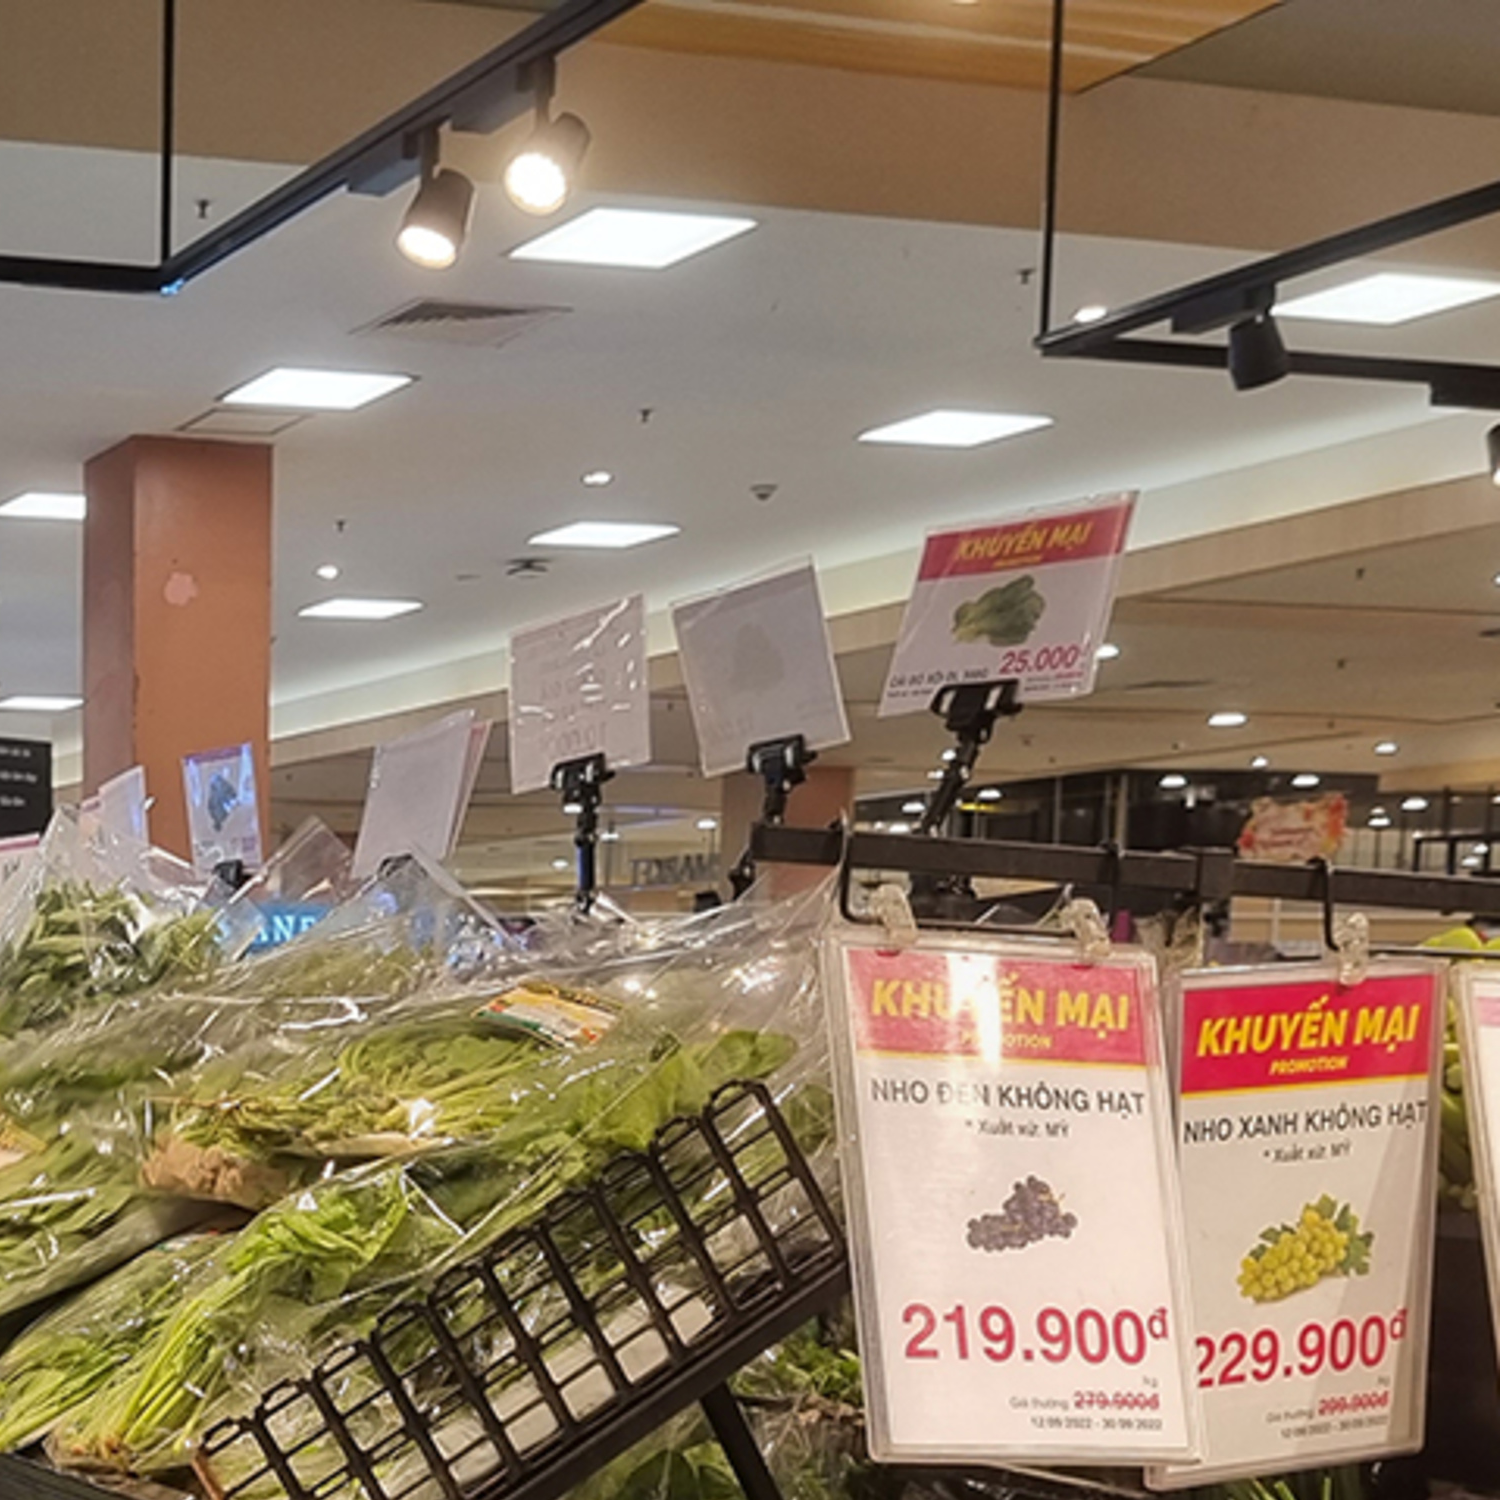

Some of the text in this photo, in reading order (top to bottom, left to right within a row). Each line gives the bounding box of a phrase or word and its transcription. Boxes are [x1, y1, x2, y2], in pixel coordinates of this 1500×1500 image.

[871, 971, 1130, 1038] KHUẾN MẠI
[1196, 995, 1420, 1058] KHUYẾN MẠI
[1268, 1056, 1350, 1076] PROMOTION
[871, 1079, 929, 1104] NHO
[999, 1081, 1090, 1112] KHÔNG
[1096, 1092, 1145, 1120] HẠT
[1183, 1101, 1429, 1144] NHO XANH KHÔNG HẠT
[902, 1303, 1169, 1365] 219.900đ
[1195, 1308, 1408, 1389] 229.900đ
